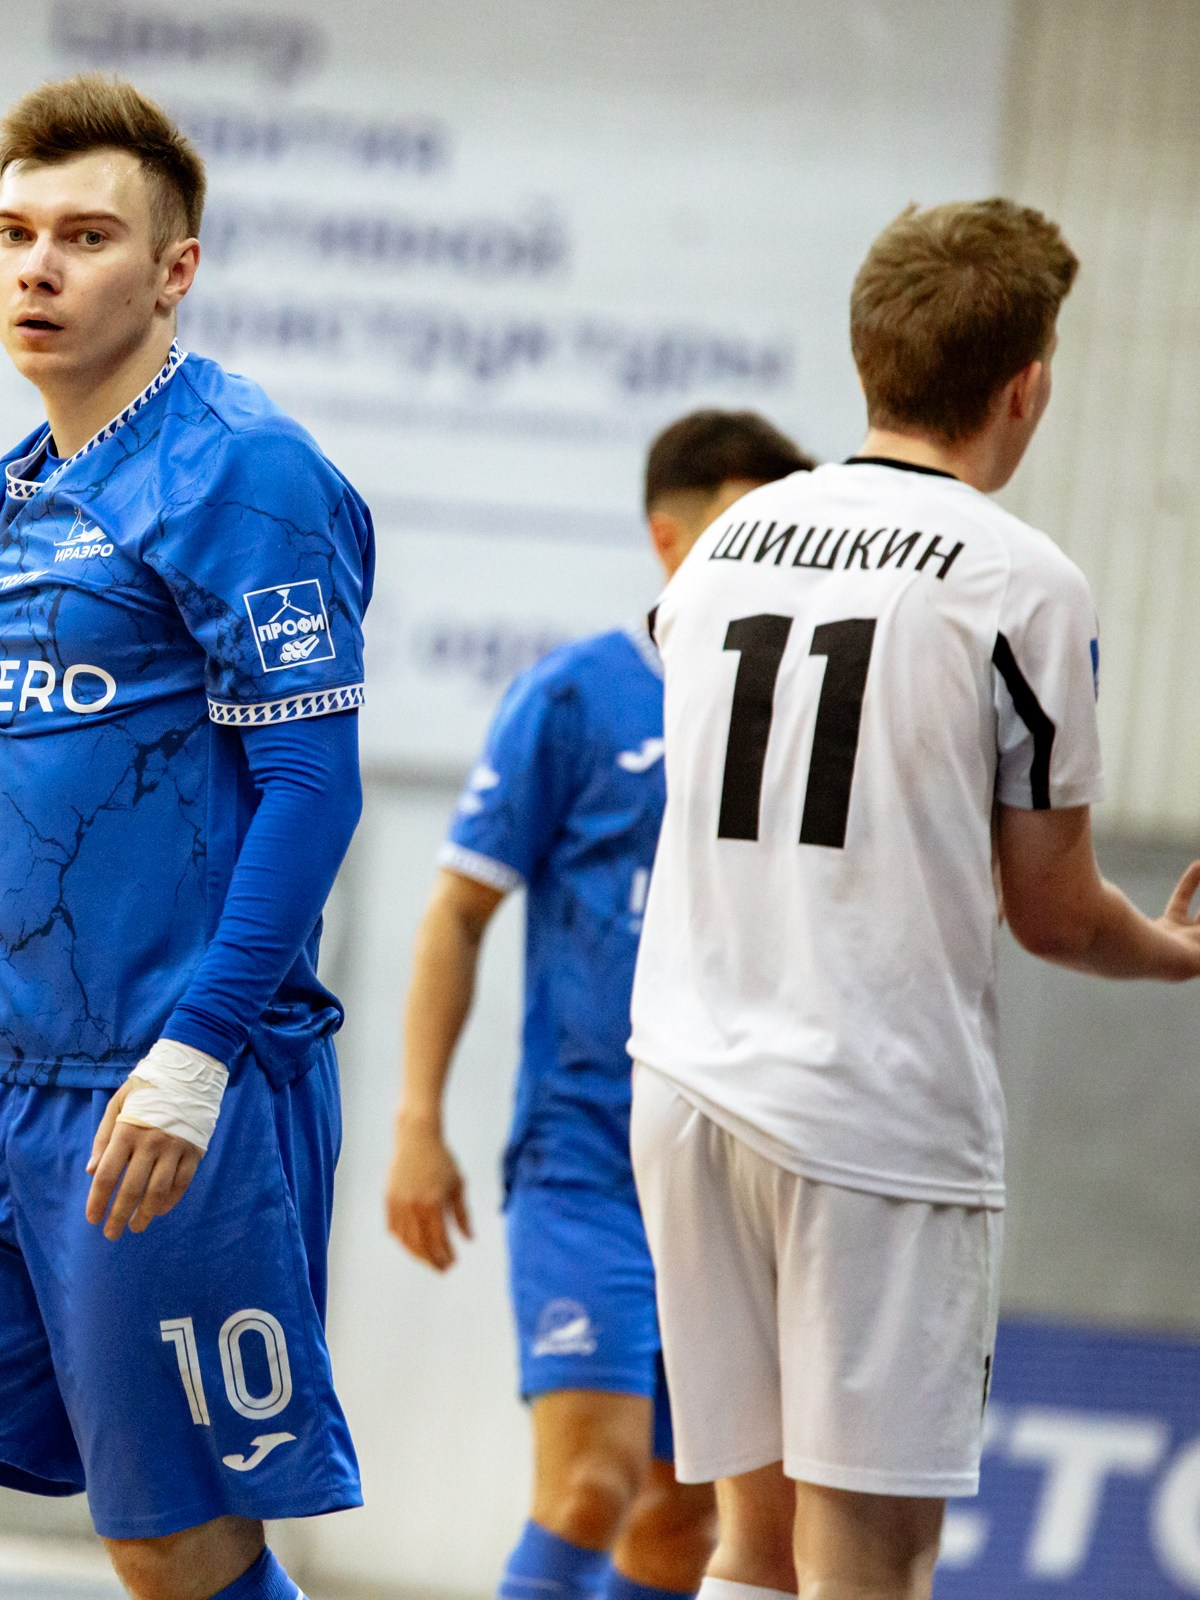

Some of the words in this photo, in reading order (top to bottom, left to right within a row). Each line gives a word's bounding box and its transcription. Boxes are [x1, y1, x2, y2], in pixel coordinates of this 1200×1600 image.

[53, 543, 114, 563] ИРАЭРО
[709, 520, 965, 581] ШИШКИН
[258, 613, 325, 642] ПРОФИ
[717, 613, 877, 849] 11
[159, 1308, 293, 1426] 10
